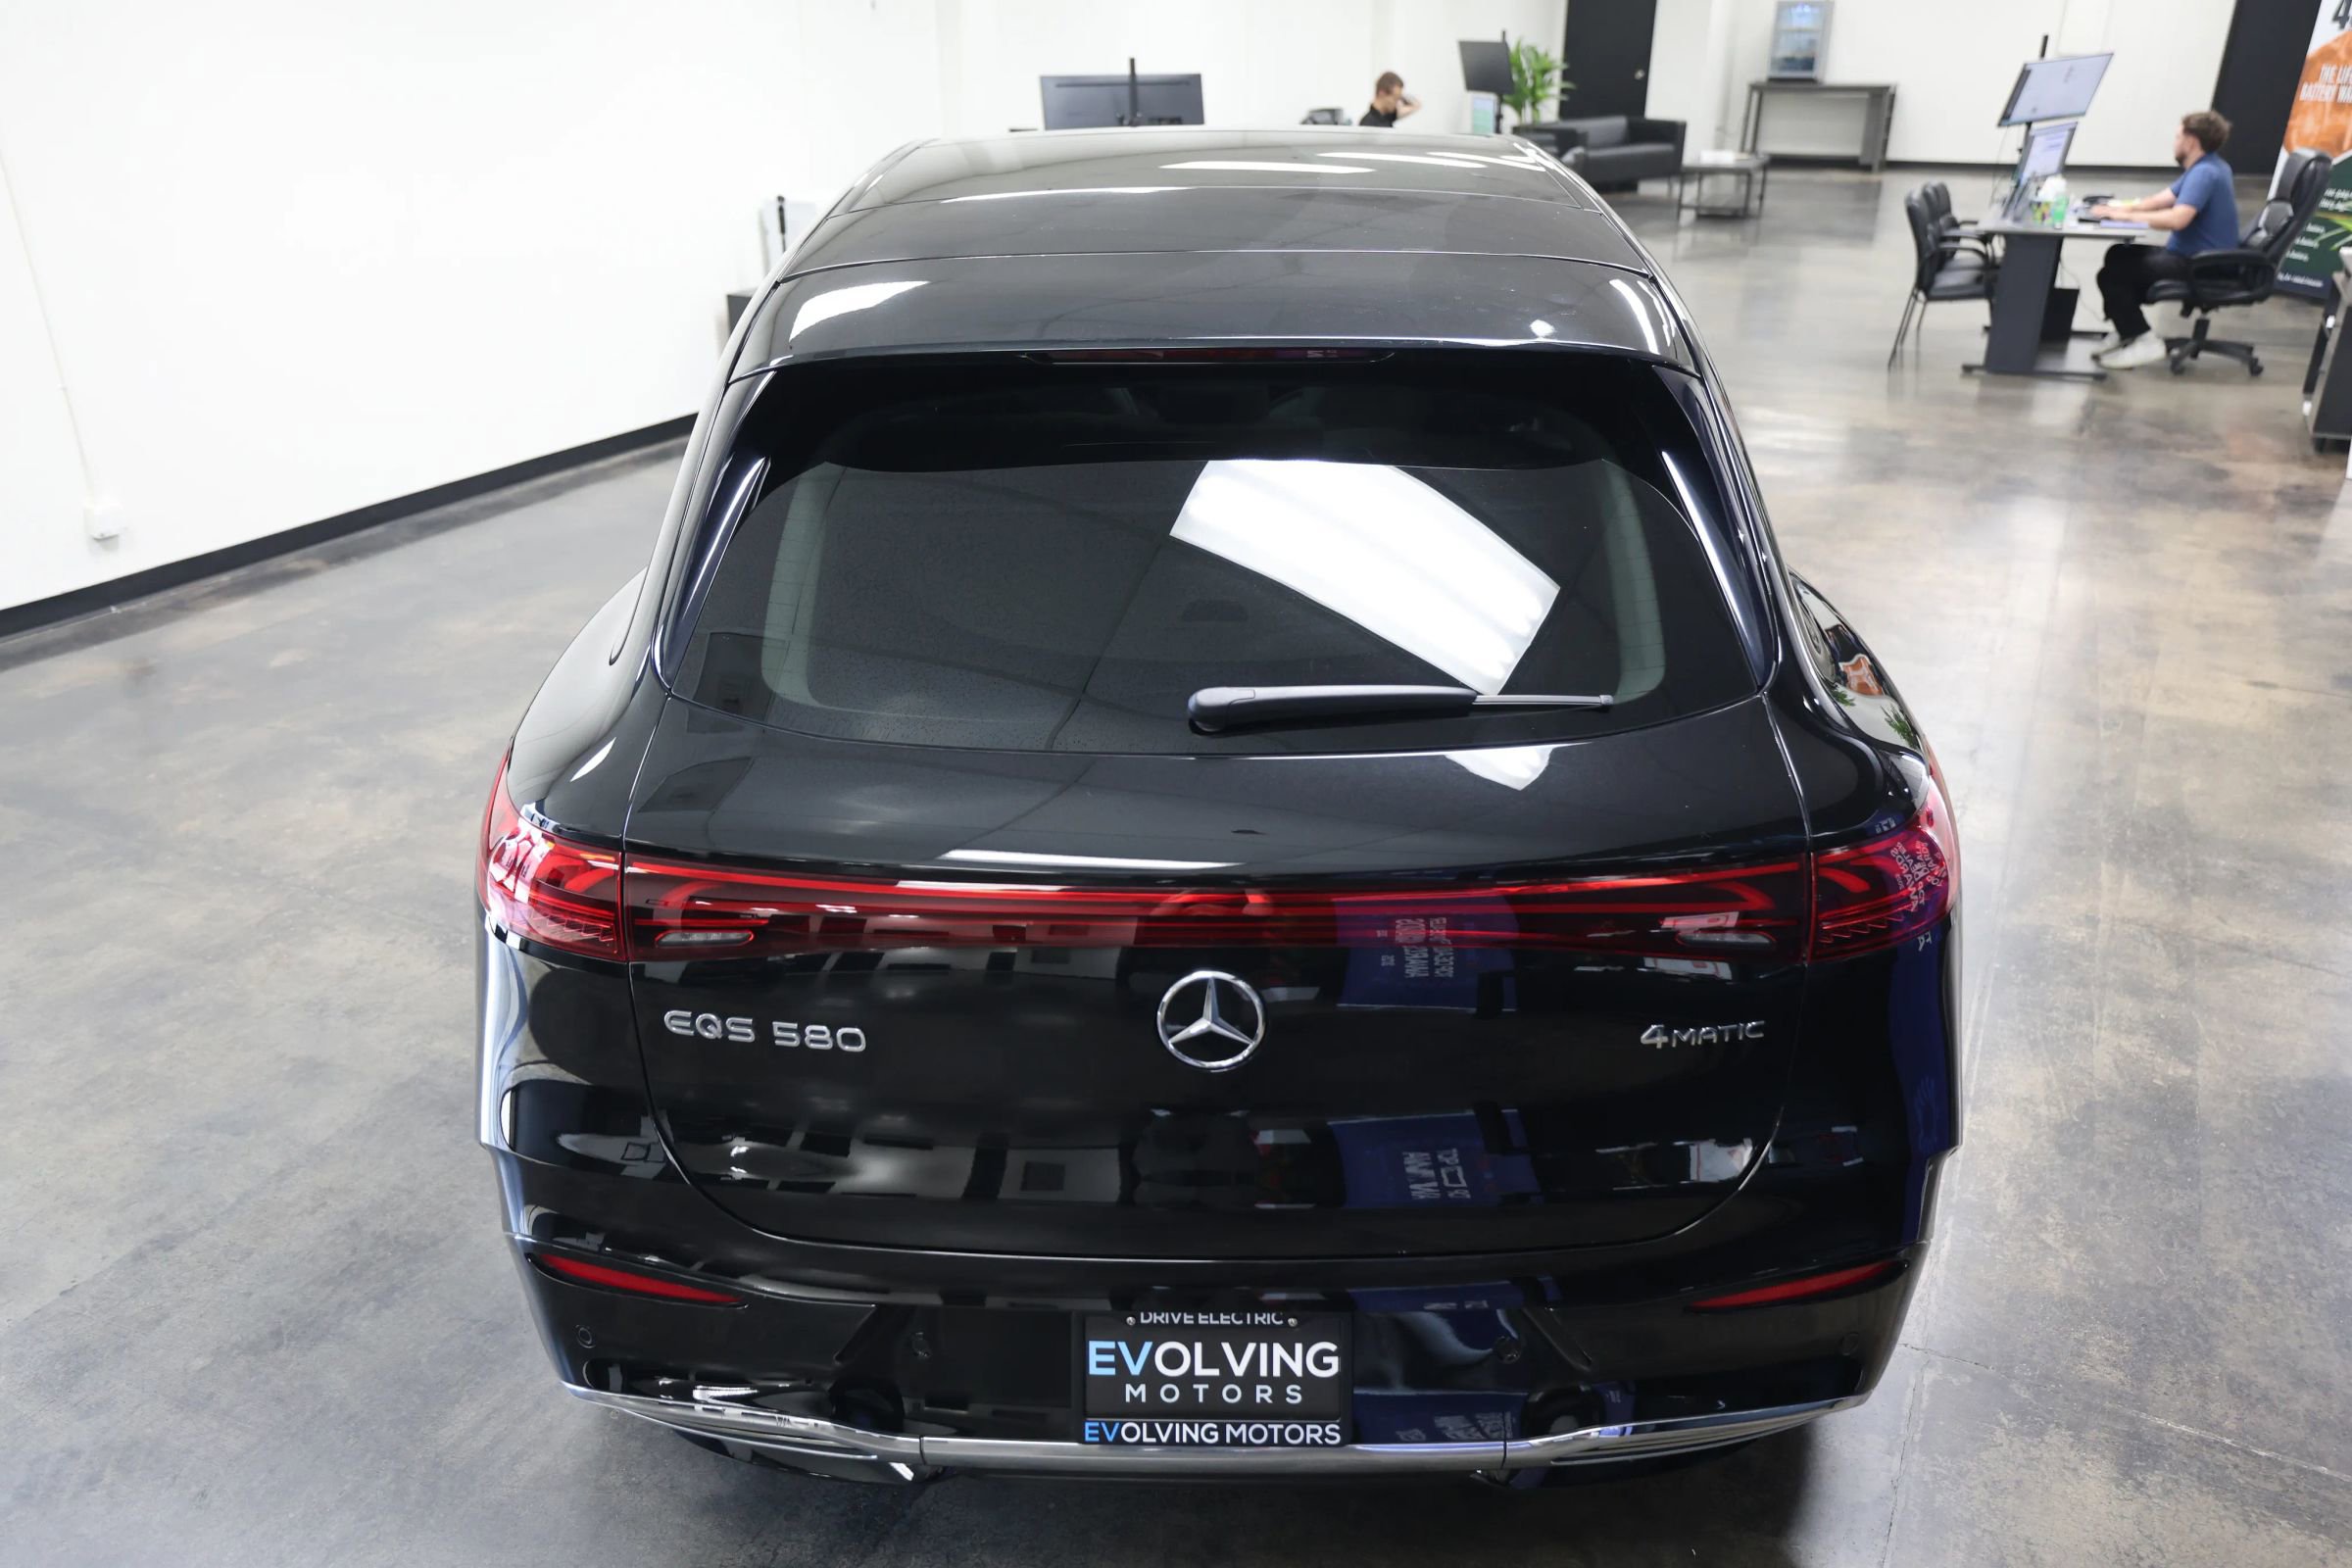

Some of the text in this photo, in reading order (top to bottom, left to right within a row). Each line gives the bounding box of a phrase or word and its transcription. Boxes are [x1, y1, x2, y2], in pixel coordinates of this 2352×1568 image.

[663, 1009, 866, 1053] EQS 580
[1640, 1020, 1765, 1050] 4MATIC
[1140, 1311, 1284, 1326] DRIVE ELECTRIC
[1088, 1340, 1340, 1378] EVOLVING
[1125, 1383, 1303, 1404] MOTORS
[1085, 1421, 1342, 1446] EVOLVING MOTORS
